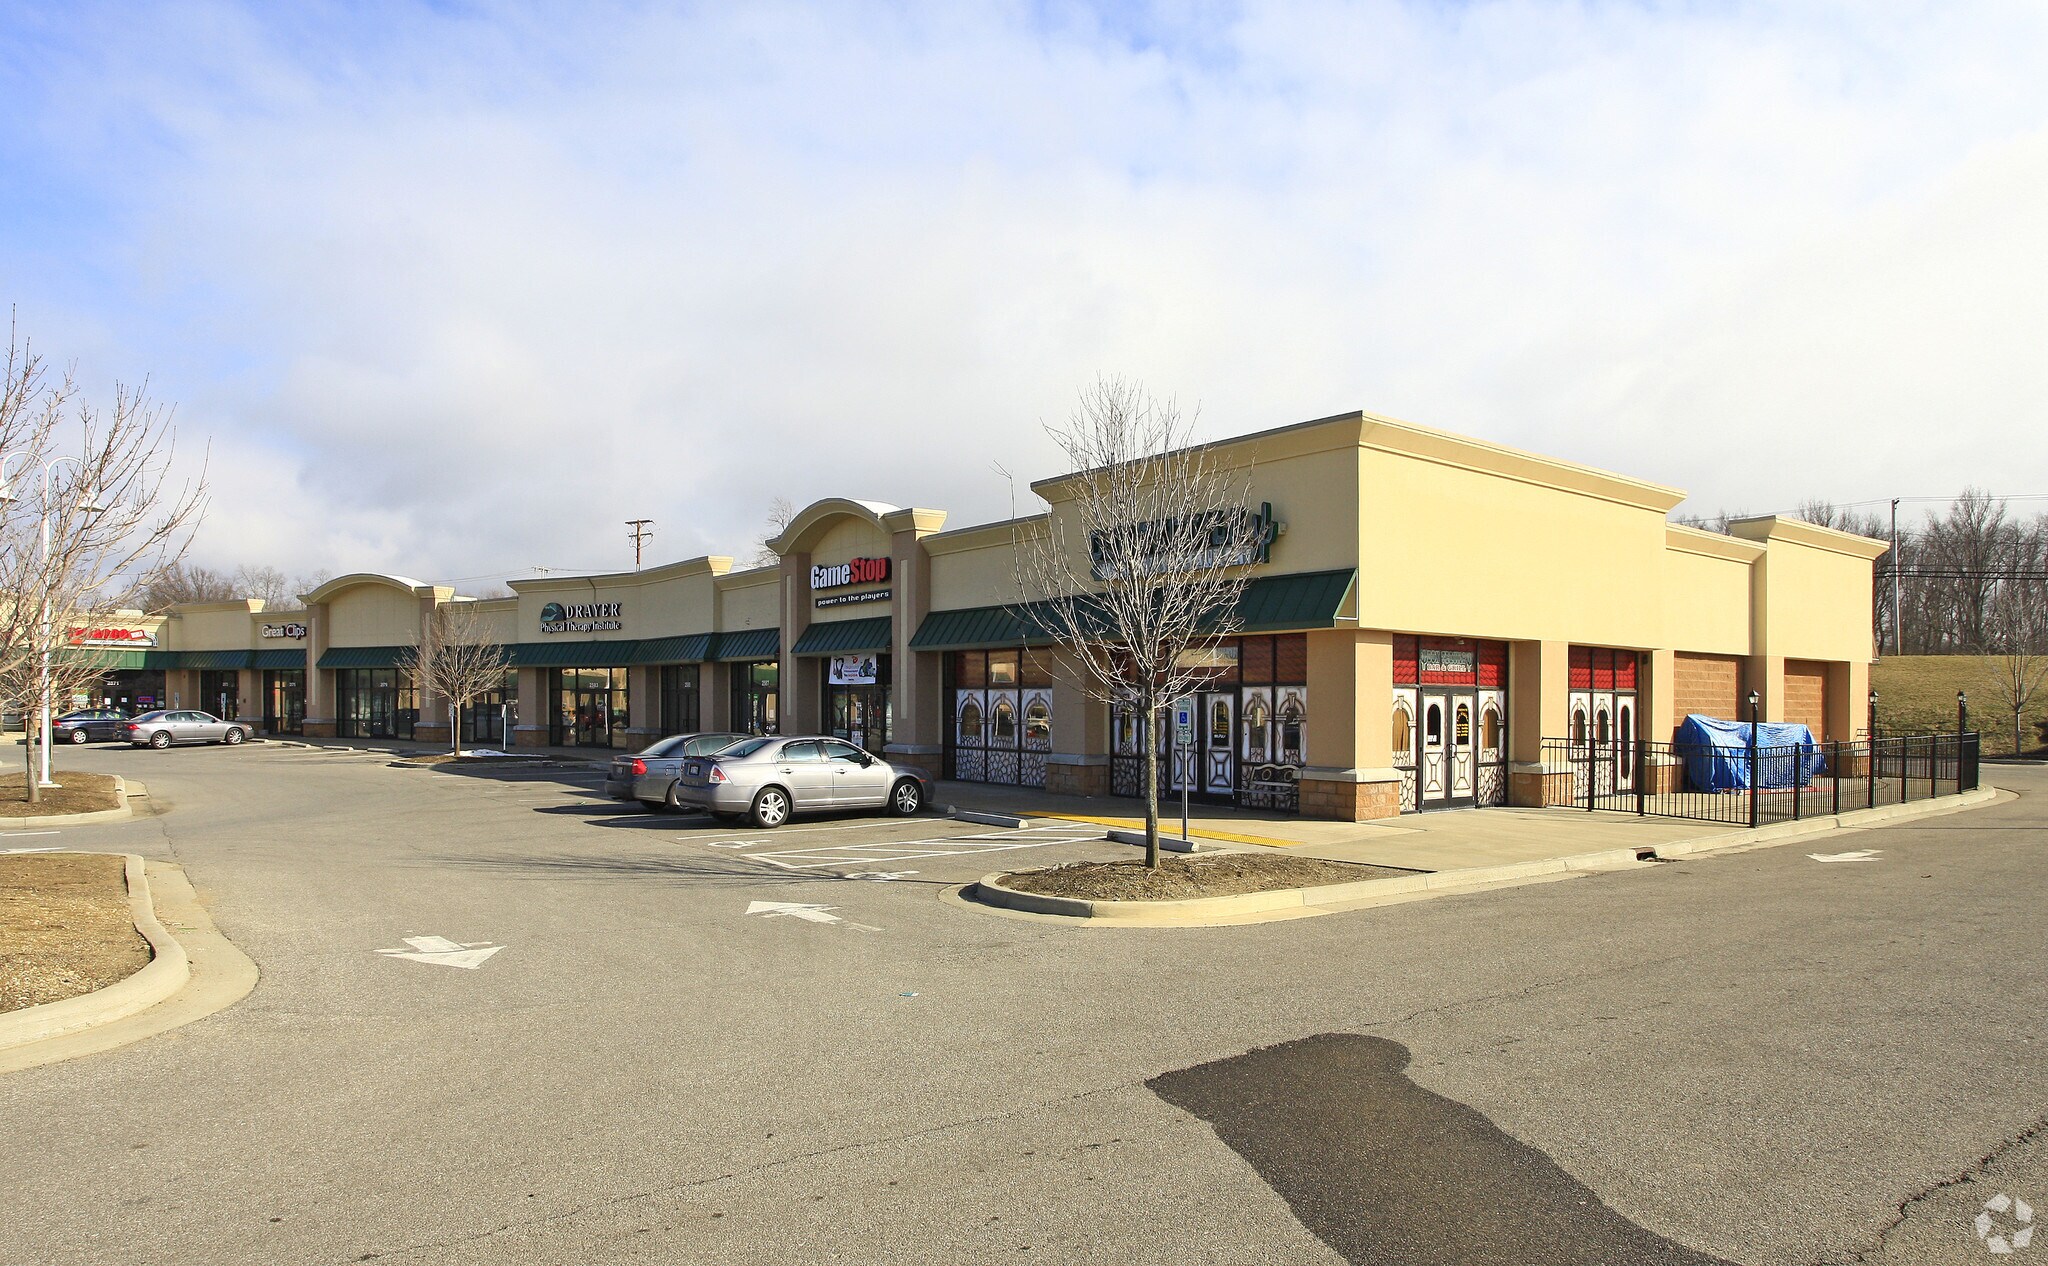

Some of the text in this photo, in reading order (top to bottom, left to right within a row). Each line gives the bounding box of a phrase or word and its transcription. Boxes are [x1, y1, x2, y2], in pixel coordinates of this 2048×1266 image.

[810, 558, 888, 589] GameStop
[817, 599, 838, 607] power
[861, 592, 889, 601] players
[566, 602, 620, 618] DRAYER
[261, 624, 306, 640] Great Clips
[540, 620, 621, 633] Physical Therapy Institute
